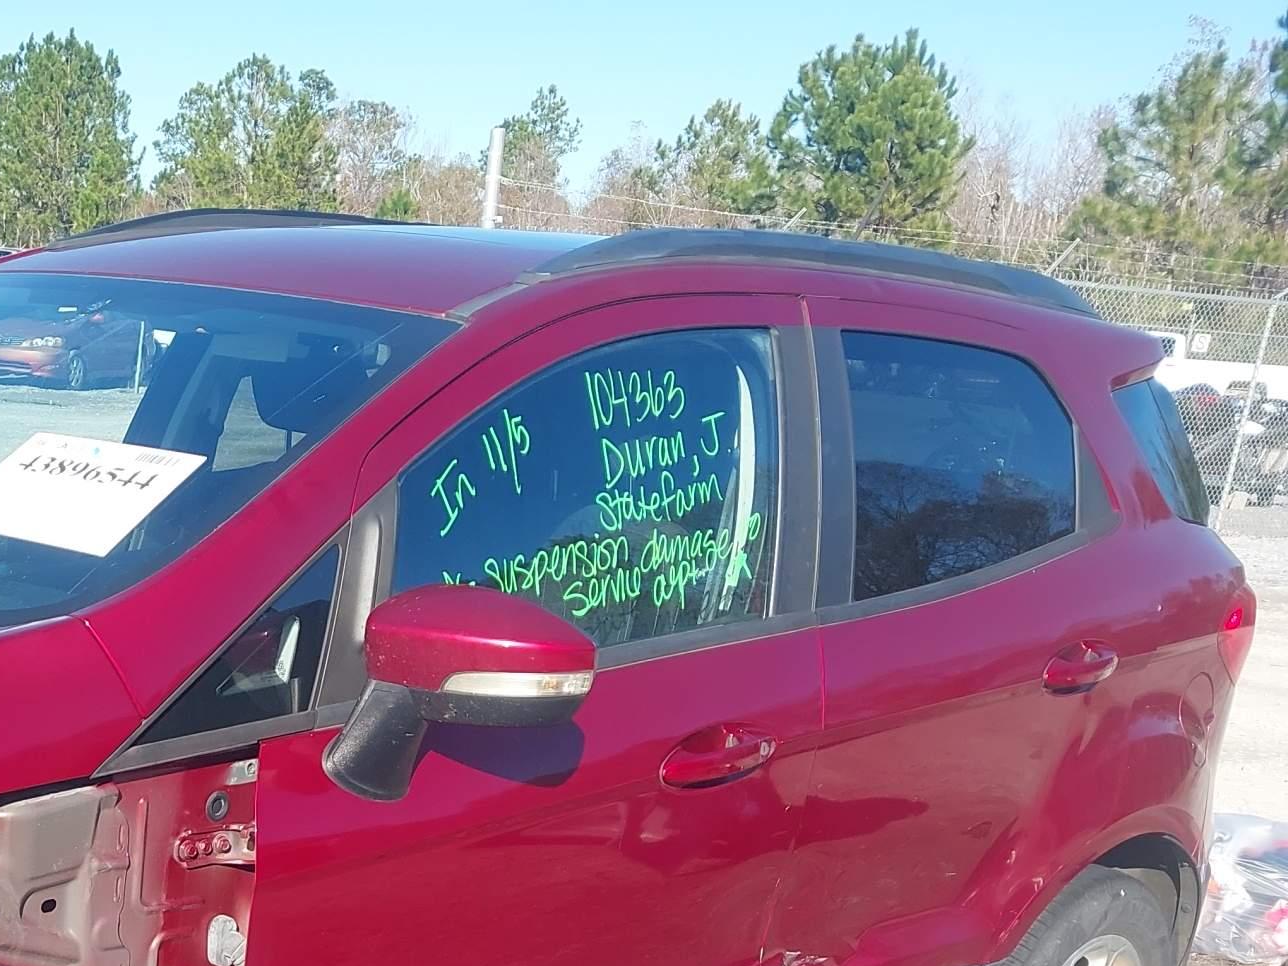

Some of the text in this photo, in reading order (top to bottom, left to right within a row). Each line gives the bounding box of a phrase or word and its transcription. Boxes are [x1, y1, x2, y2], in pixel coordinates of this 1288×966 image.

[584, 368, 685, 430] 104363
[19, 454, 160, 490] 43896544
[431, 409, 530, 536] In 11/5
